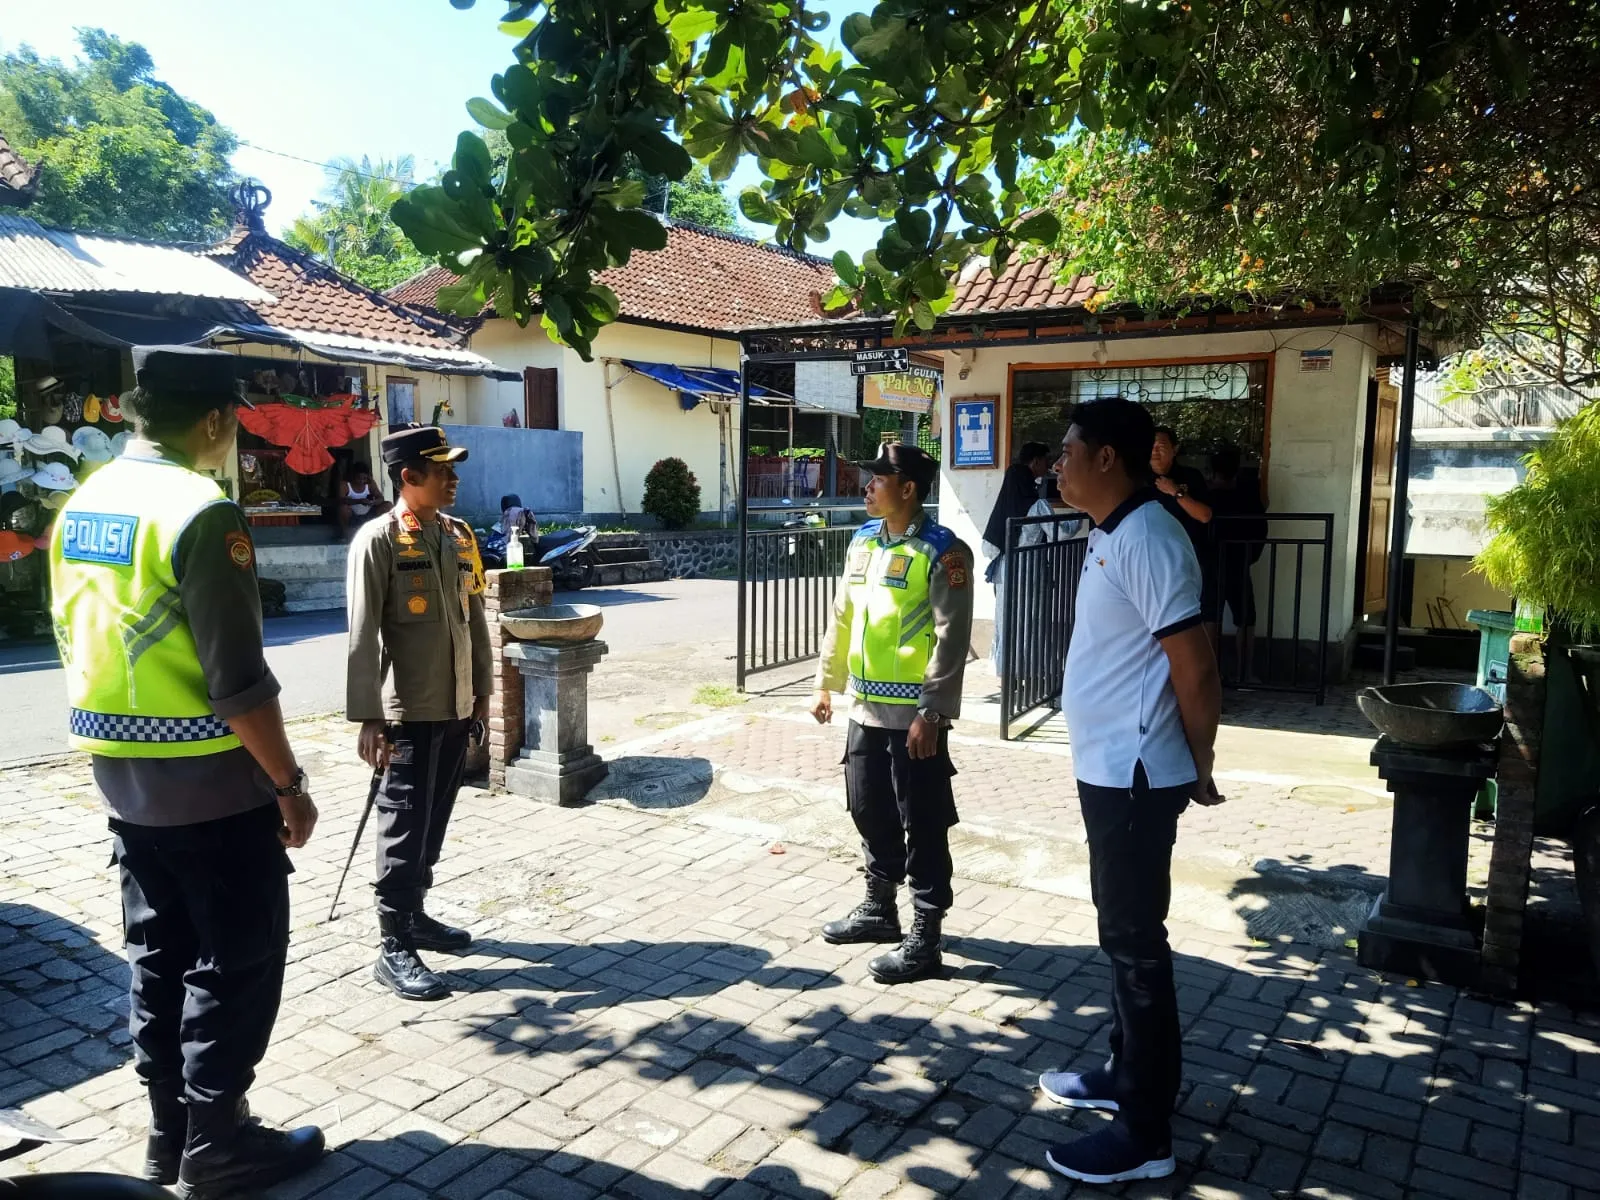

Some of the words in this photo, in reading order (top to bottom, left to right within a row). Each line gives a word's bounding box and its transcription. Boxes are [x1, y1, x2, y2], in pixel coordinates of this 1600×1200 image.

[856, 352, 884, 361] MASUK
[914, 368, 939, 379] GULIN
[883, 374, 911, 394] Pak
[64, 518, 131, 558] POLISI
